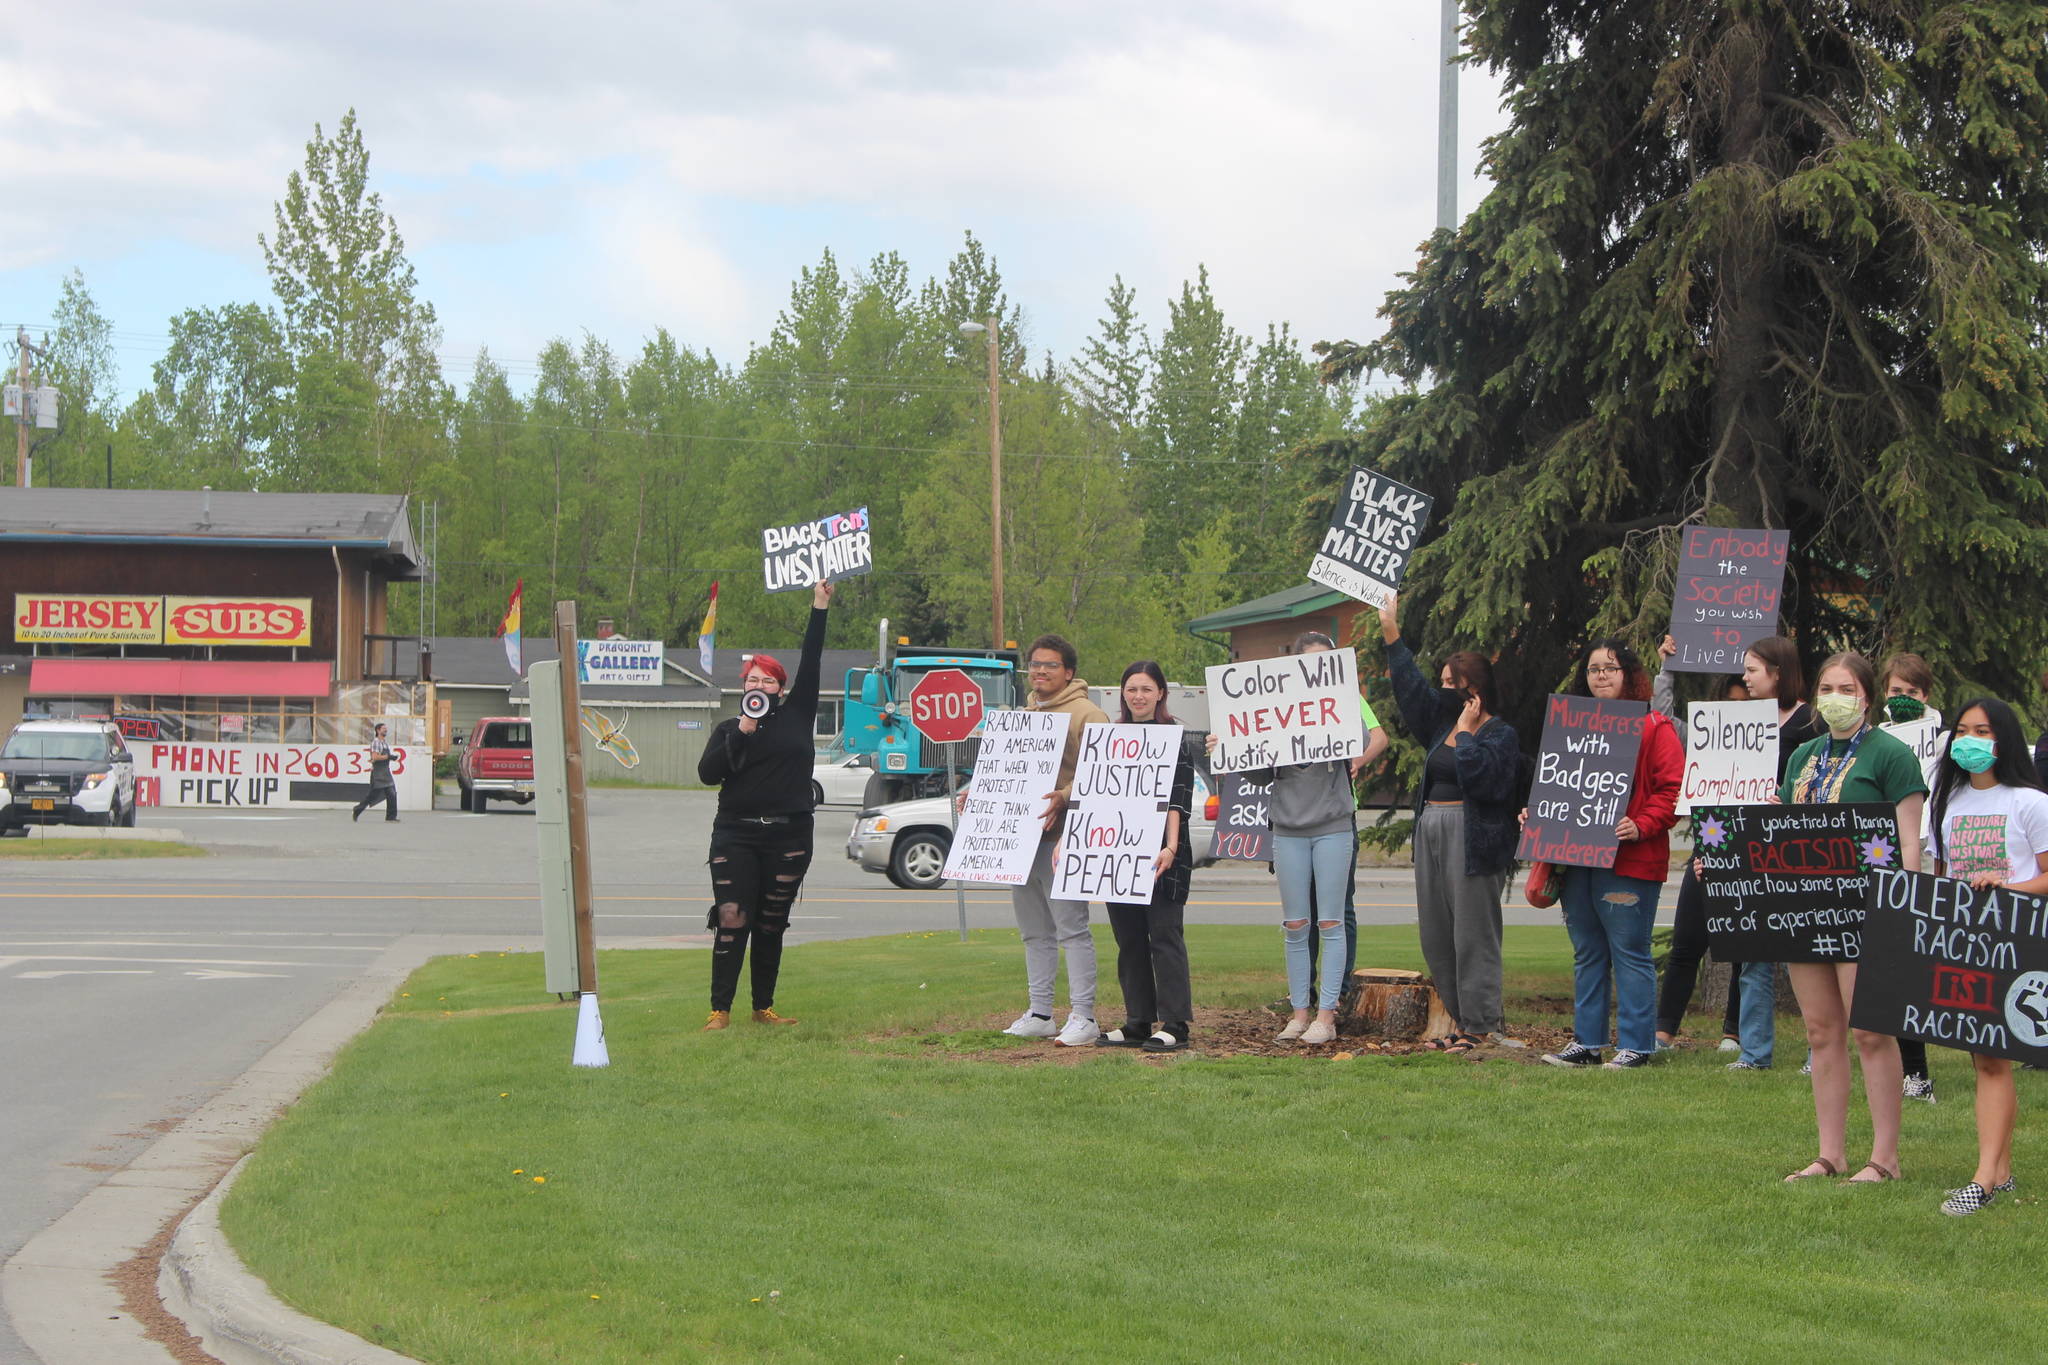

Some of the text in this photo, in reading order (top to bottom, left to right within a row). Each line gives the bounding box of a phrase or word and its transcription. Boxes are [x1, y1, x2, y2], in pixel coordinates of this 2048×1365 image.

[1350, 470, 1425, 524] BLACK
[764, 521, 827, 553] BLACK
[1344, 501, 1417, 551] LIVES
[764, 531, 871, 589] LIVES MATTER
[1321, 527, 1403, 582] MATTER
[1688, 530, 1786, 565] Embody
[1312, 560, 1347, 590] Silence
[1718, 560, 1748, 576] the
[1686, 577, 1777, 612] Society
[19, 600, 159, 629] JERSEY
[183, 608, 294, 634] SUBS
[1695, 608, 1763, 622] you wish
[1711, 626, 1741, 645] to
[590, 656, 660, 669] GALLERY
[1682, 644, 1725, 665] Live
[1222, 654, 1345, 699] Color Will
[916, 691, 978, 721] STOP
[1228, 697, 1341, 737] NEVER
[1550, 698, 1645, 736] Murderers
[116, 719, 158, 739] OPEN
[986, 711, 1053, 732] RACISM IS
[152, 744, 242, 775] PHONE
[256, 752, 278, 774] IN
[981, 738, 1056, 755] SO AMERICAN
[1083, 727, 1167, 762] K(no)w
[1213, 734, 1357, 771] Justify Murder
[1566, 733, 1610, 756] with
[976, 760, 1054, 774] THAT WHEN YOU
[1078, 764, 1170, 798] JUSTICE
[1538, 752, 1629, 799] Badges
[180, 777, 279, 805] PICK UP
[976, 779, 1015, 793] PROTEST
[1685, 760, 1775, 806] Compliance
[965, 799, 1031, 816] PEOPLE THINK
[1537, 797, 1619, 827] are still
[1731, 806, 1747, 833] if
[1800, 812, 1828, 829] tired
[1831, 812, 1846, 829] of
[1852, 808, 1896, 836] hearing
[973, 818, 1020, 834] YOU ARE
[1066, 811, 1143, 849] K(no)w
[1951, 829, 2005, 847] NEUTRAL
[963, 835, 1019, 851] PROTESTING
[1216, 831, 1262, 859] YOU
[1519, 826, 1618, 868] Murderers
[942, 869, 1023, 882] BLACK LIVES MATTER
[1062, 853, 1151, 897] PEACE
[1700, 852, 1741, 870] about
[1705, 873, 1870, 911] imagine how some peopl
[1707, 917, 1734, 934] are
[1740, 911, 1757, 931] of
